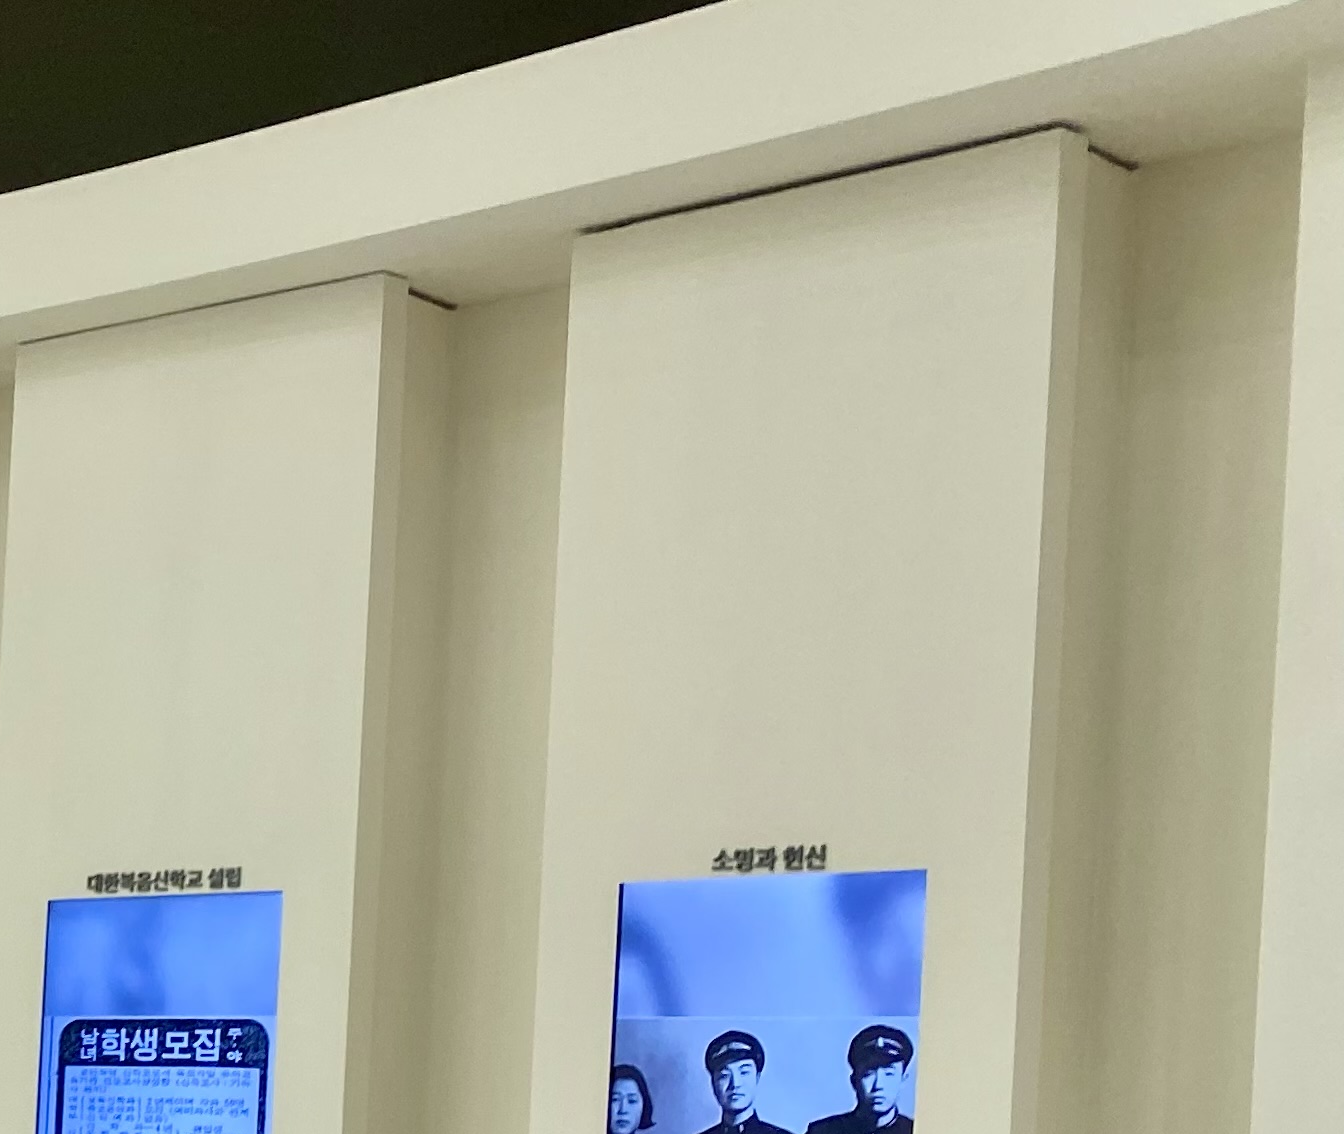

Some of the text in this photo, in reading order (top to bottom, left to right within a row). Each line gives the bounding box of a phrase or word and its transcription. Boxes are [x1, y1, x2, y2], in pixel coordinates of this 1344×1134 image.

[711, 843, 828, 873] 소명과 헌신
[86, 866, 243, 894] 대한복음신학교 설립
[101, 1027, 223, 1063] 학생모집
